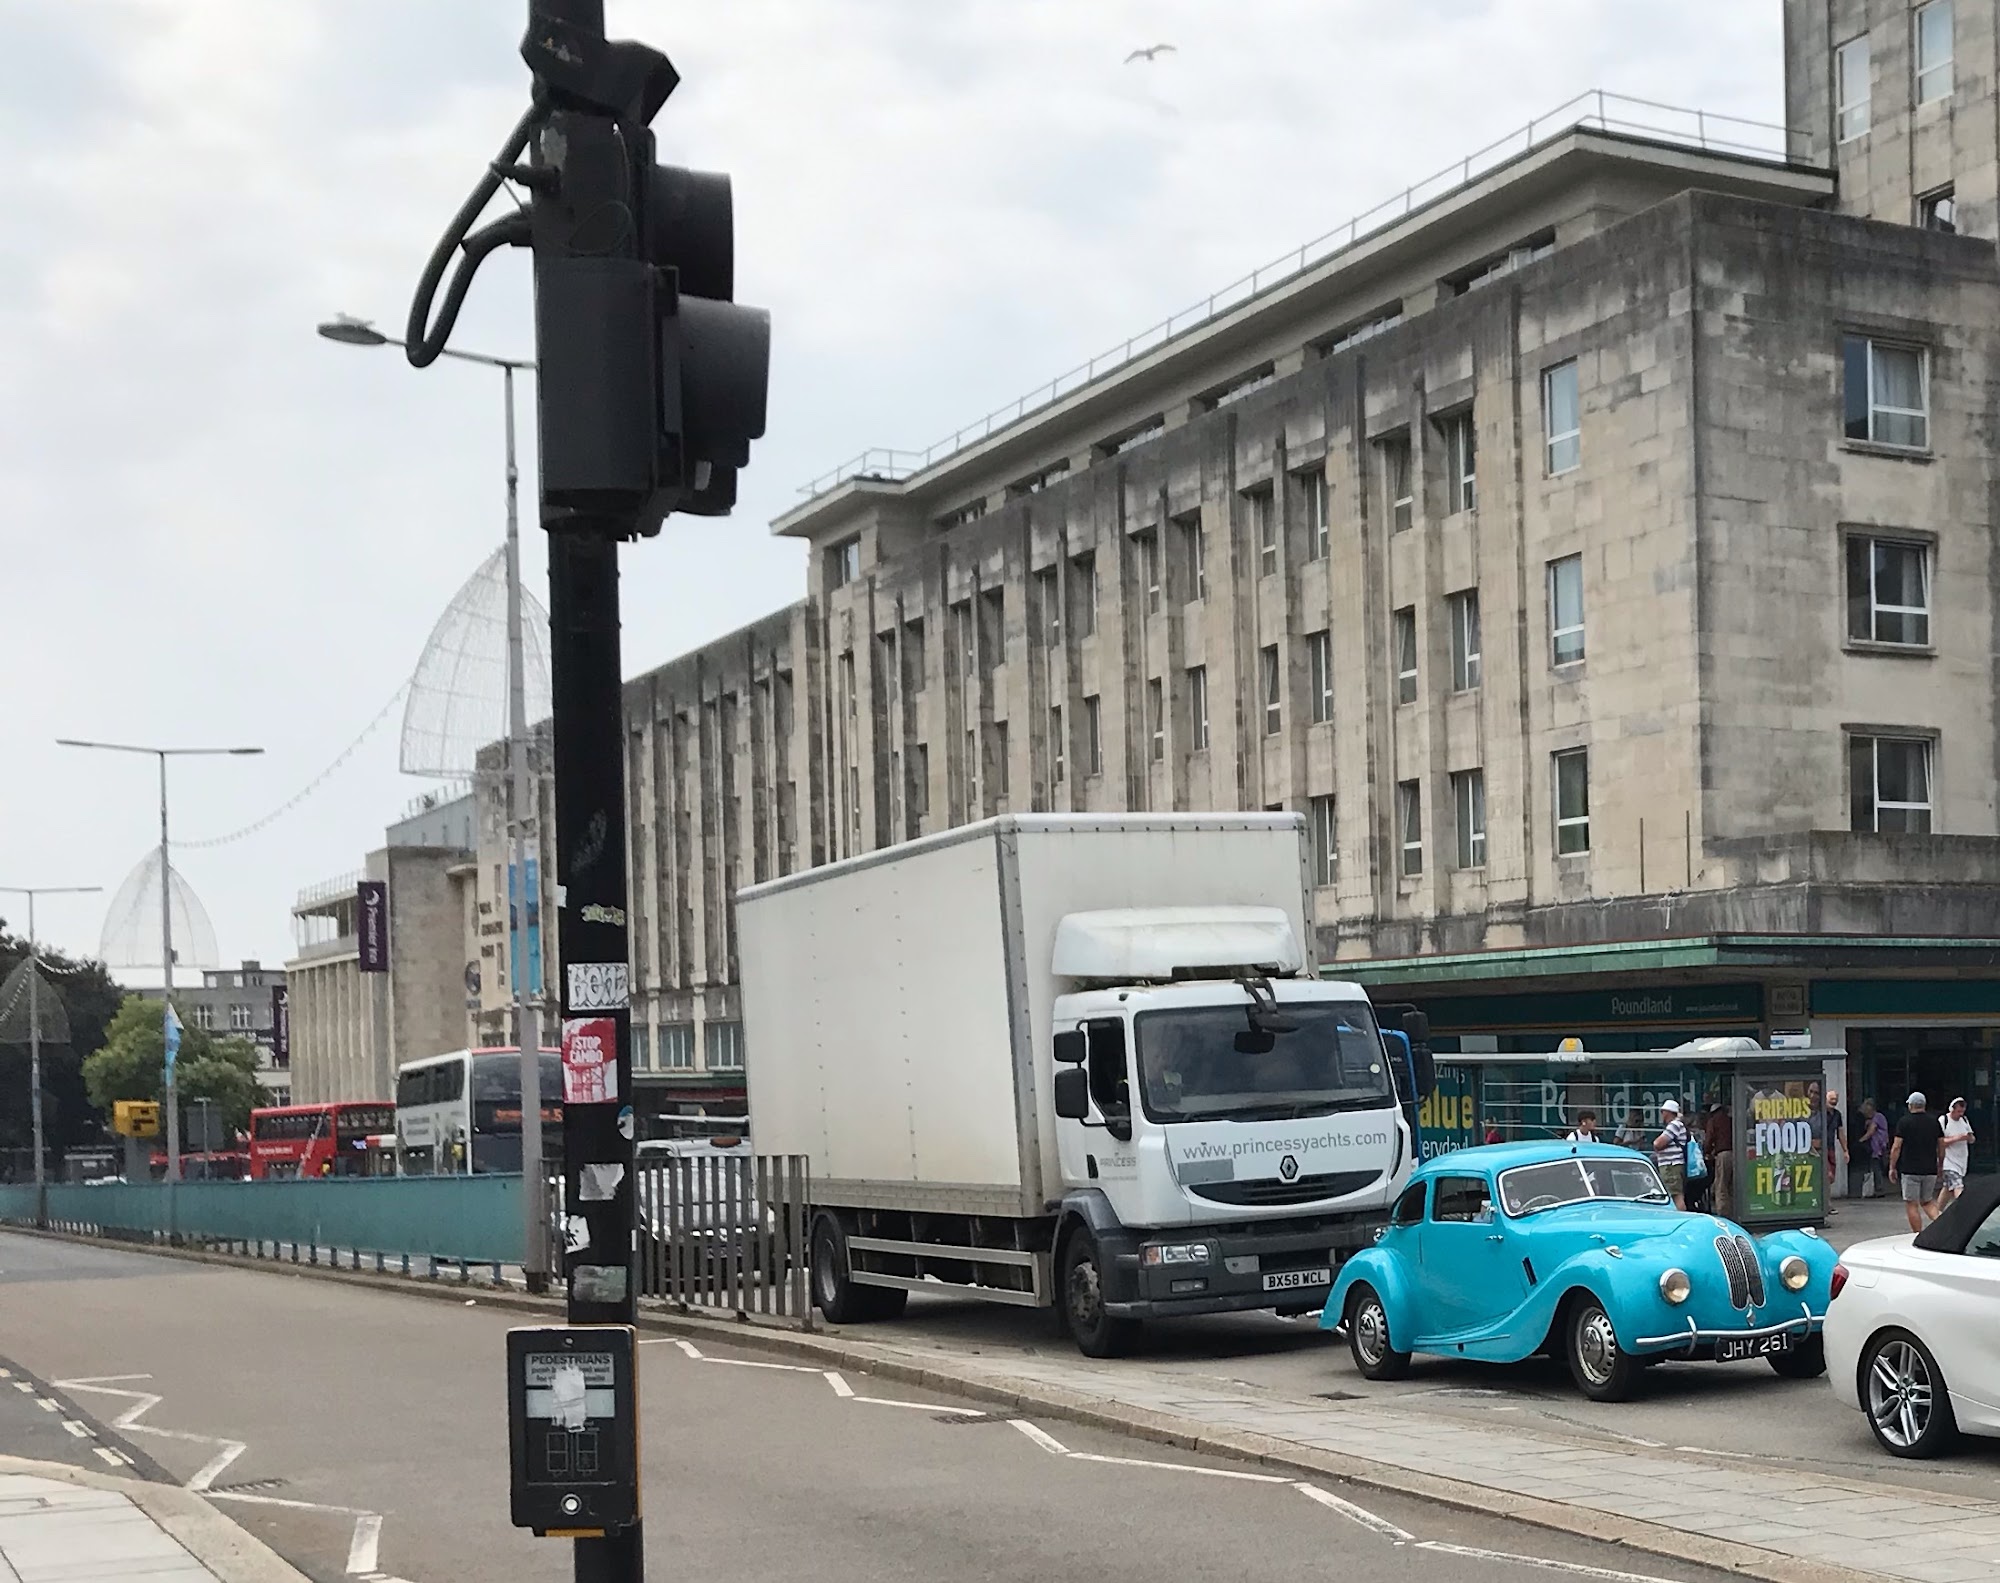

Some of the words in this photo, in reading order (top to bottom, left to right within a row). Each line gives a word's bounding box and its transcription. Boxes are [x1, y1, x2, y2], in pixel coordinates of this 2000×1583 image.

[1611, 996, 1672, 1015] Poundland
[1419, 1085, 1473, 1129] alue
[1755, 1097, 1811, 1120] FRIENDS
[1183, 1132, 1387, 1159] www.princessyachts.com
[1755, 1121, 1812, 1156] FOOD
[1268, 1274, 1299, 1288] BX58
[1302, 1272, 1326, 1286] WCL
[1722, 1339, 1754, 1358] JHY
[1759, 1332, 1788, 1353] 261
[531, 1355, 611, 1364] PEDESTRIANS
